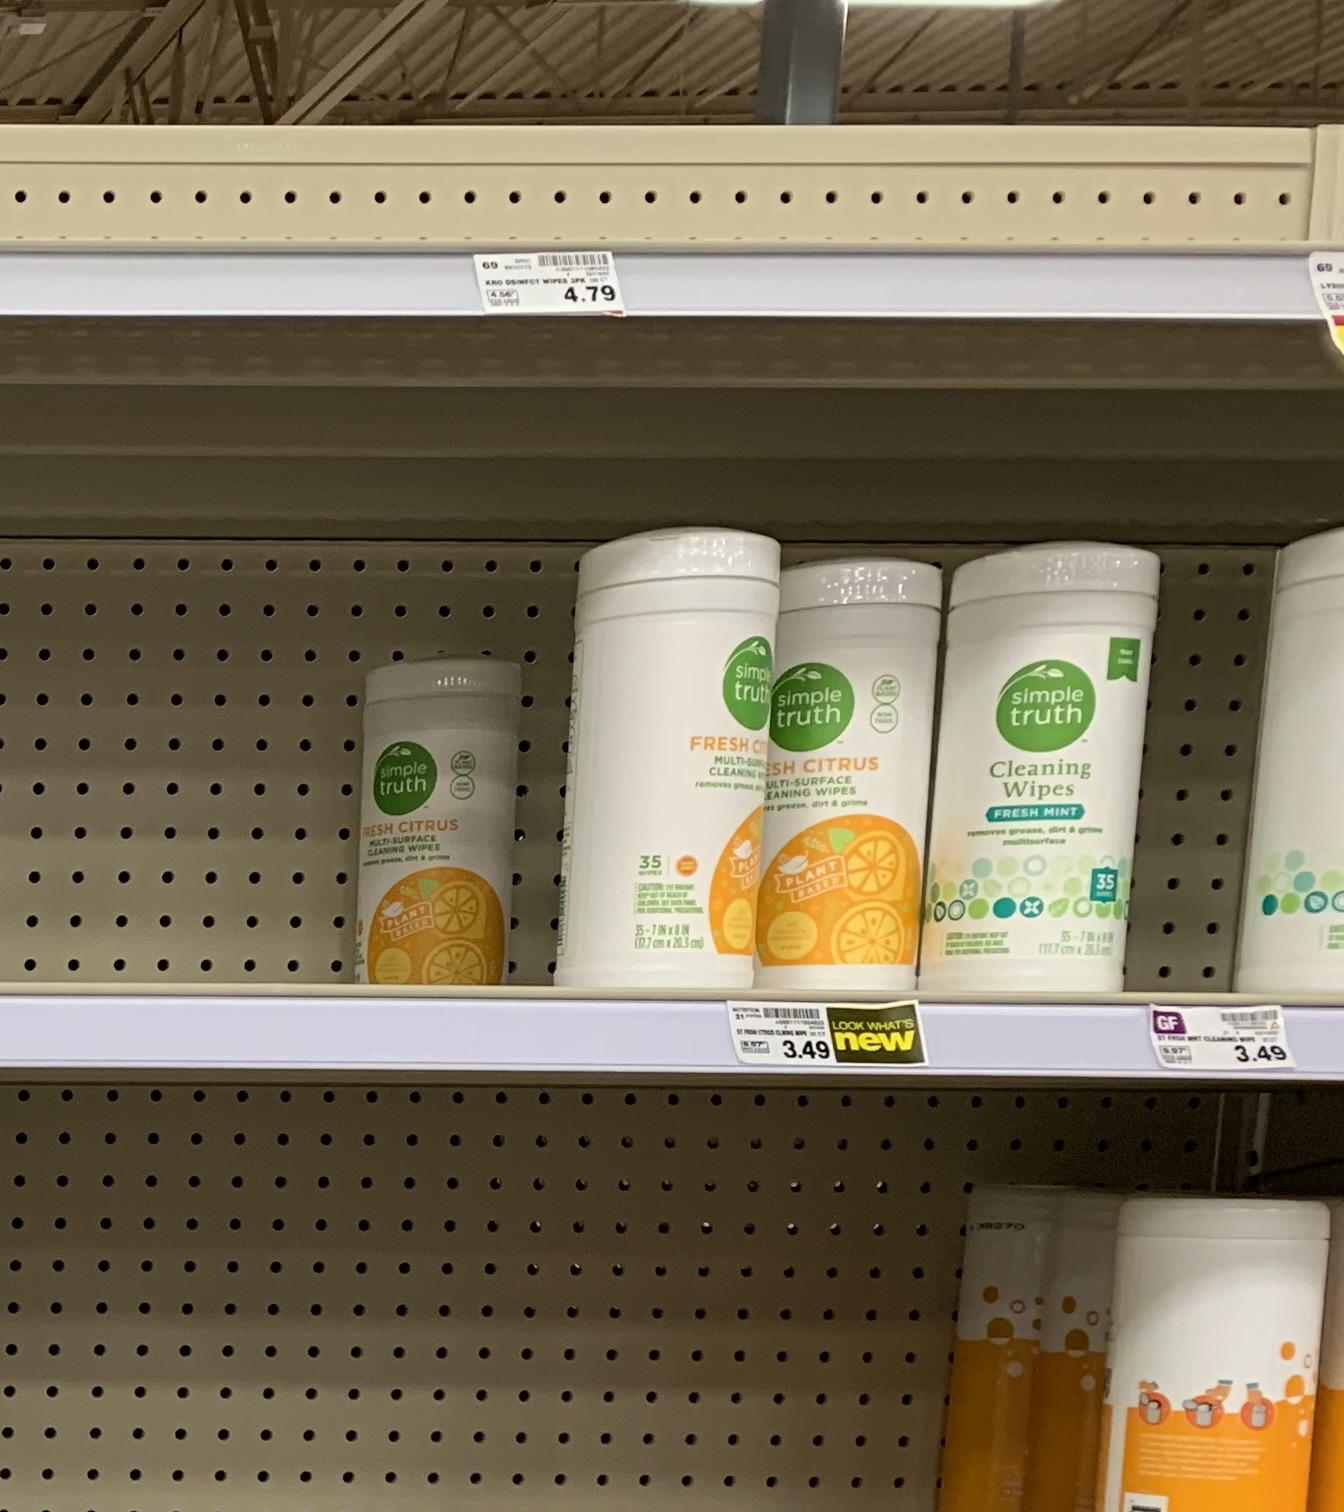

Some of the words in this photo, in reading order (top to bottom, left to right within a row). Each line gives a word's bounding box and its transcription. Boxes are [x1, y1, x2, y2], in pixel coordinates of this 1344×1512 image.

[482, 261, 499, 270] 69
[563, 285, 617, 303] 4.79
[777, 687, 843, 708] simple
[1011, 686, 1084, 706] simple
[776, 704, 841, 729] truth
[1010, 703, 1083, 727] truth
[690, 736, 749, 752] FRESH
[379, 761, 428, 779] simple
[803, 756, 880, 774] CITRUS
[989, 758, 1092, 780] Cleaning
[379, 777, 427, 796] truth
[815, 786, 857, 797] WIPES
[1003, 780, 1075, 801] Wipes
[993, 808, 1039, 819] FRESH
[1043, 806, 1078, 817] MINT
[398, 818, 459, 834] CITRUS
[408, 843, 441, 853] WIPES
[639, 855, 662, 869] 35
[786, 860, 838, 890] PLANT
[1096, 874, 1115, 890] 35
[832, 1020, 865, 1031] LOOK
[867, 1019, 914, 1030] WHAT'S
[1157, 1015, 1178, 1030] GF
[782, 1040, 830, 1059] 3.49
[834, 1030, 915, 1052] new
[1234, 1045, 1287, 1063] 3.49
